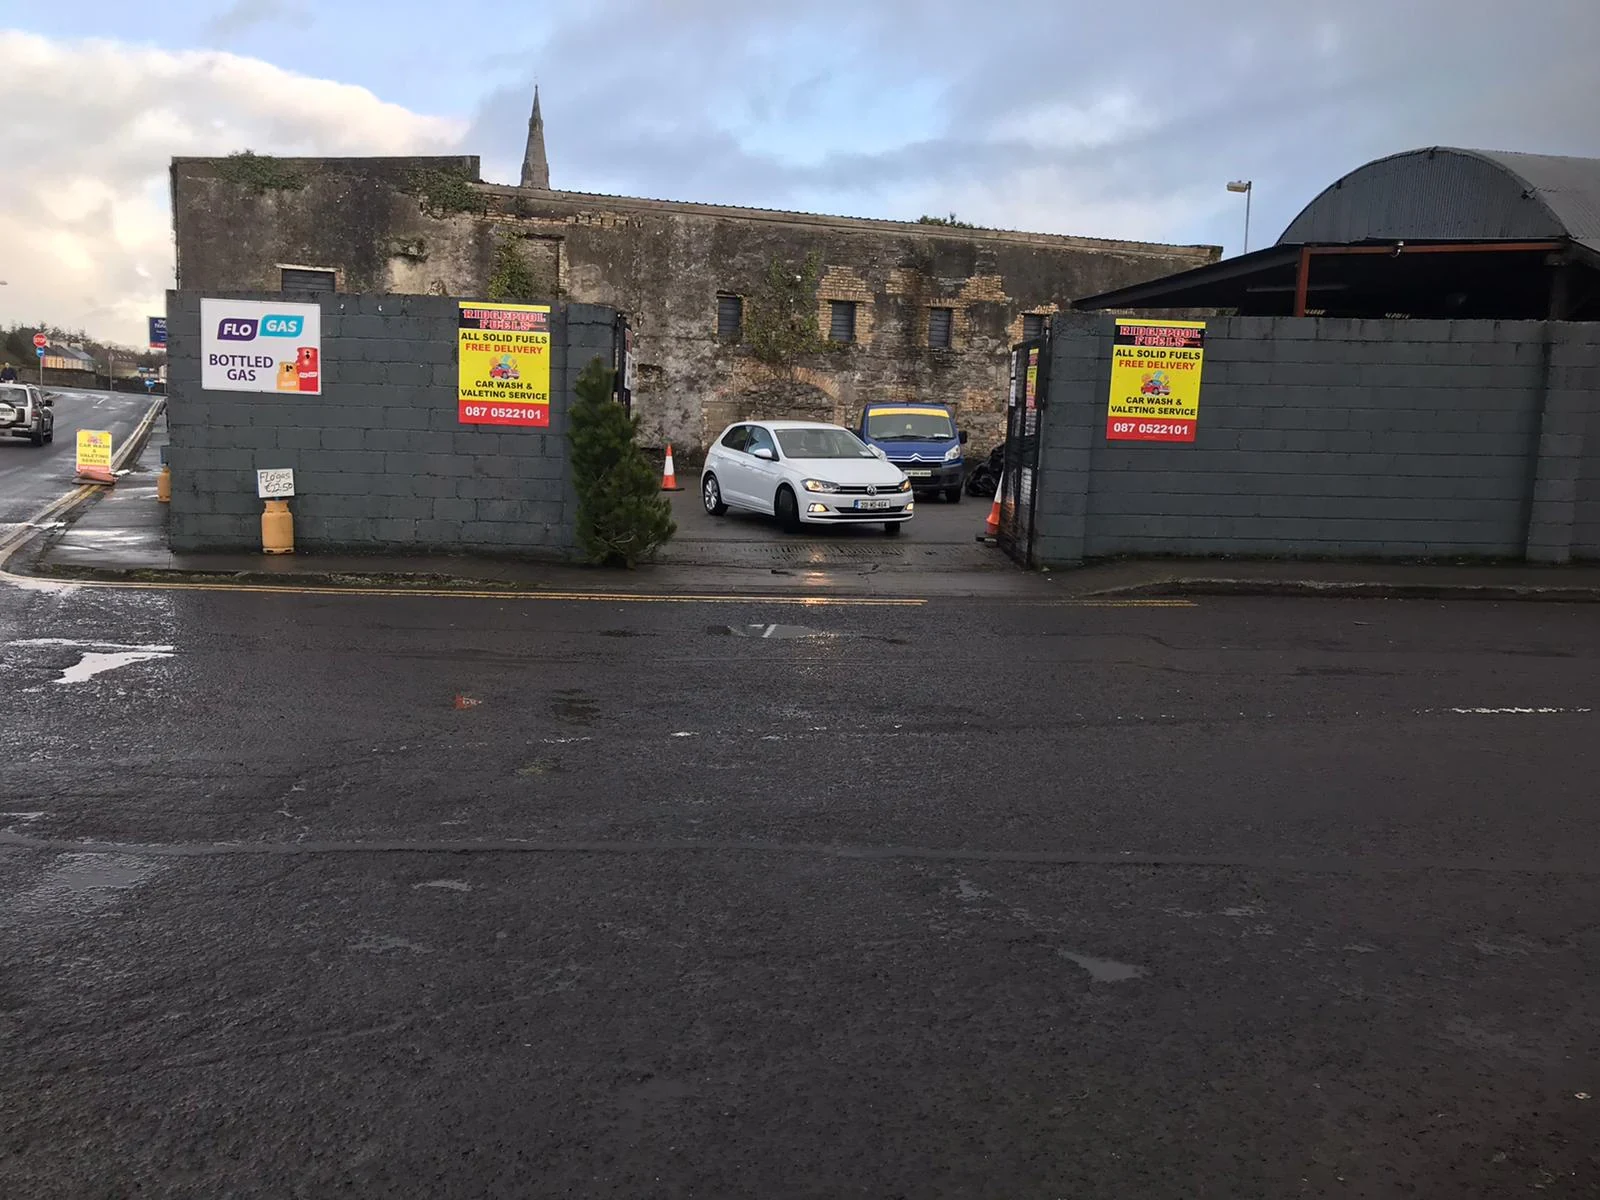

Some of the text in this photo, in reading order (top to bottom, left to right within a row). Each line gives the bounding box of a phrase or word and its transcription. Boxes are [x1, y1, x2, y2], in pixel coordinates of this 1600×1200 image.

[464, 309, 546, 323] RIDGEPOOL
[223, 320, 298, 336] FLO GAS
[480, 319, 530, 331] FUELS
[461, 332, 548, 345] ALL SOLID FUELS
[1119, 326, 1201, 339] RIDGEPOOL
[1135, 336, 1185, 348] FUELS
[465, 343, 543, 354] FREE DELIVERY
[1115, 349, 1201, 360] ALL SOLID FUELS
[209, 354, 274, 369] BOTTLED
[1119, 360, 1196, 370] FREE DELIVERY
[227, 369, 256, 381] GAS
[475, 380, 533, 390] CAR WASH &
[461, 389, 547, 400] VALETING SERVICE
[1126, 397, 1182, 406] CAR WASH &
[465, 406, 541, 419] 087 0522101
[1111, 406, 1196, 416] VALETING SERVICE
[1113, 422, 1188, 435] 087 0522101
